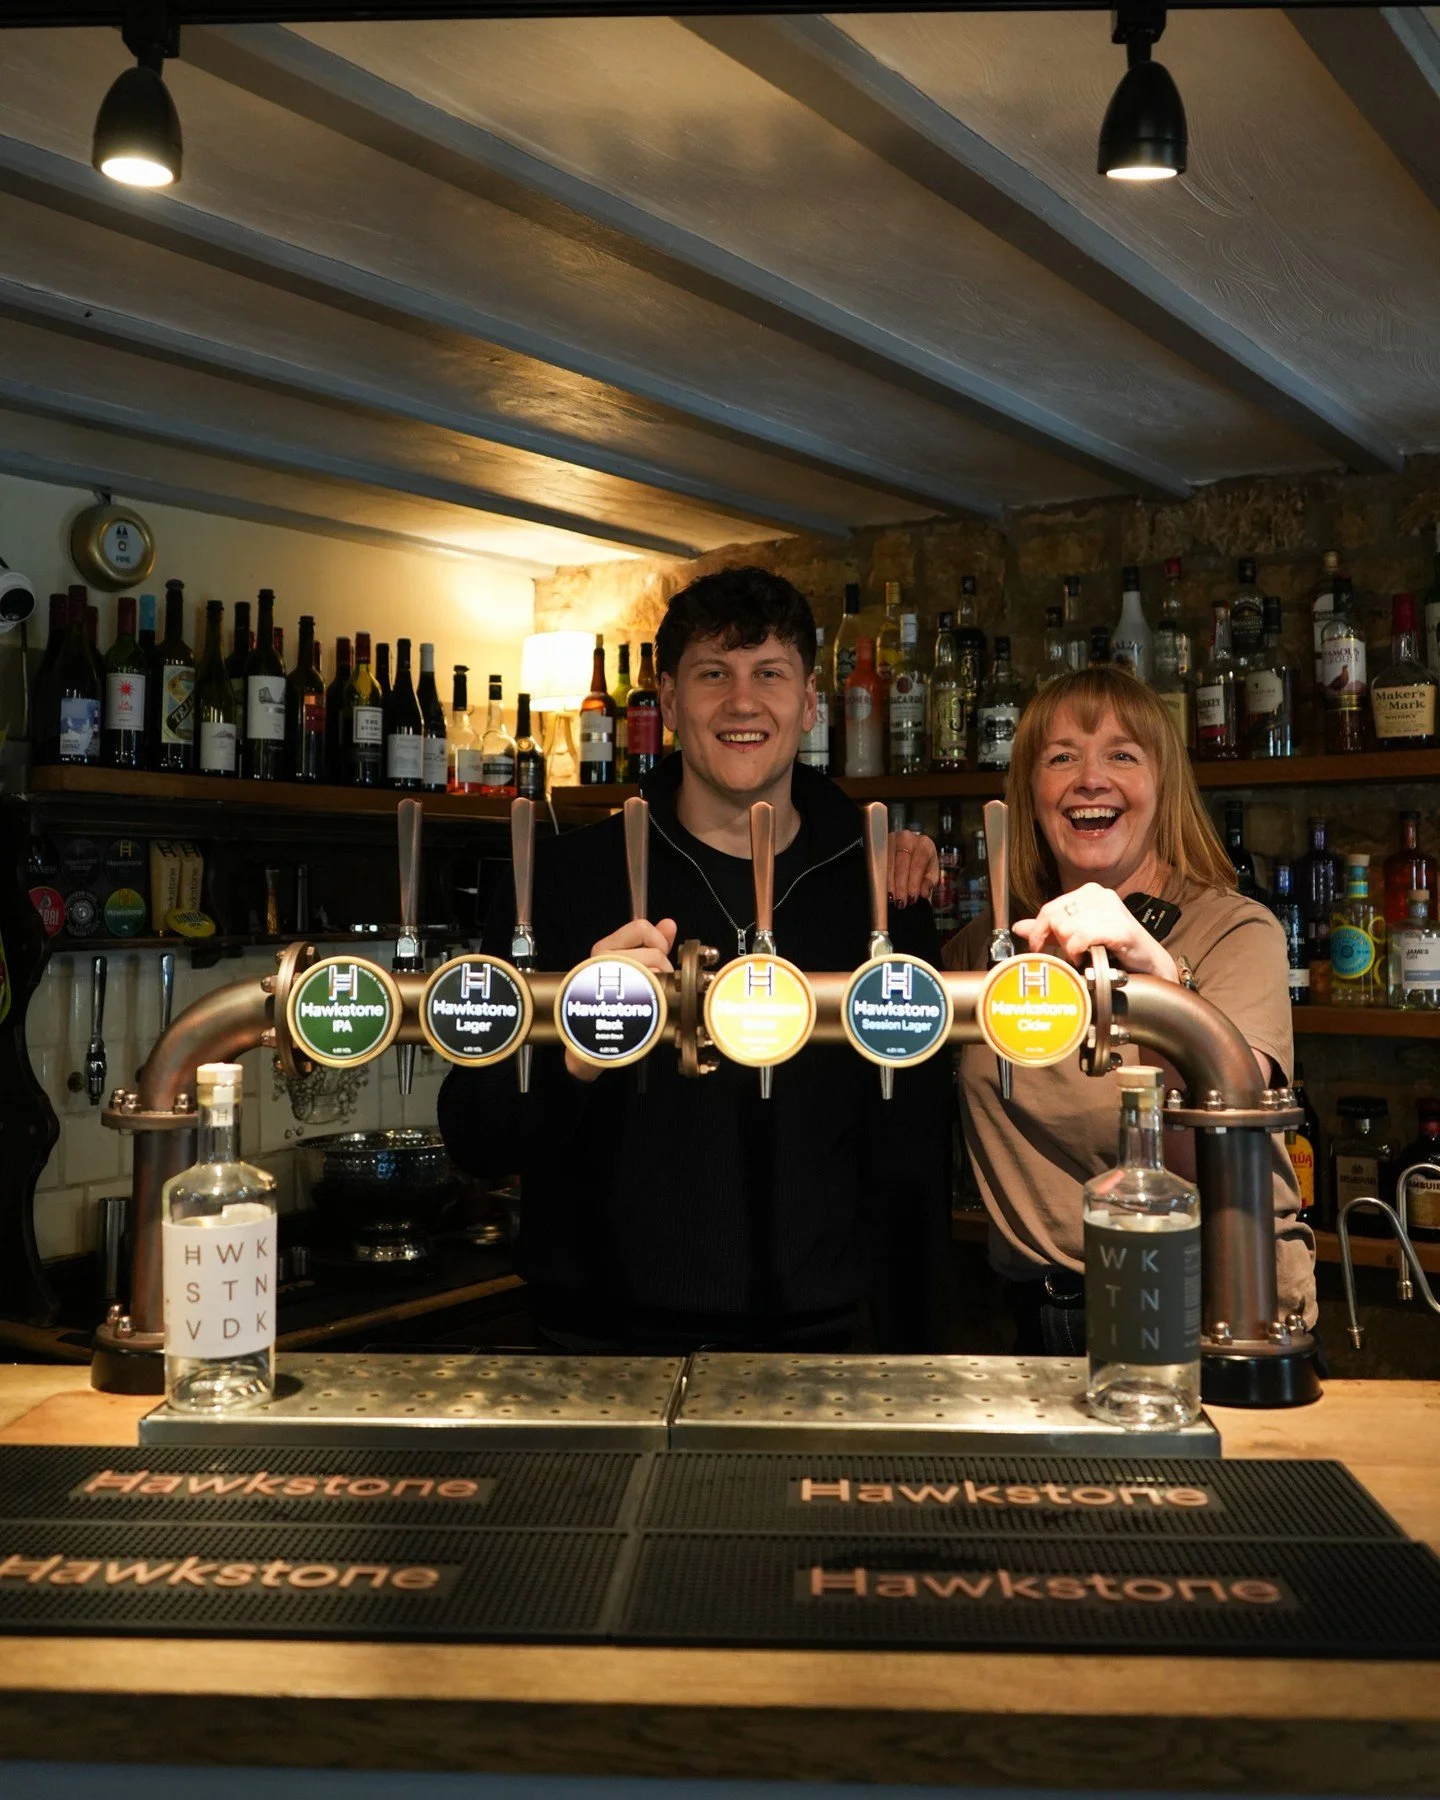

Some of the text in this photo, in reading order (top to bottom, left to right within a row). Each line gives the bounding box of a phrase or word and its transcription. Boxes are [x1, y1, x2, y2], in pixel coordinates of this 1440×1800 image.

[1375, 689, 1426, 701] Maker's
[1388, 699, 1426, 711] Mark
[301, 1002, 385, 1018] Hawkstone
[433, 999, 517, 1017] Hawkstone
[567, 1000, 653, 1017] Hawkstone
[854, 999, 940, 1018] Hawkstone
[991, 1000, 1078, 1016] Hawkstone
[332, 1019, 354, 1033] IPA
[456, 1018, 492, 1035] Lager
[862, 1018, 932, 1034] Session Lager
[83, 1469, 478, 1498] Hawkstone
[801, 1476, 1209, 1507] Hawkstone
[0, 1553, 440, 1590] Hawkstone
[810, 1565, 1281, 1605] Hawkstone
